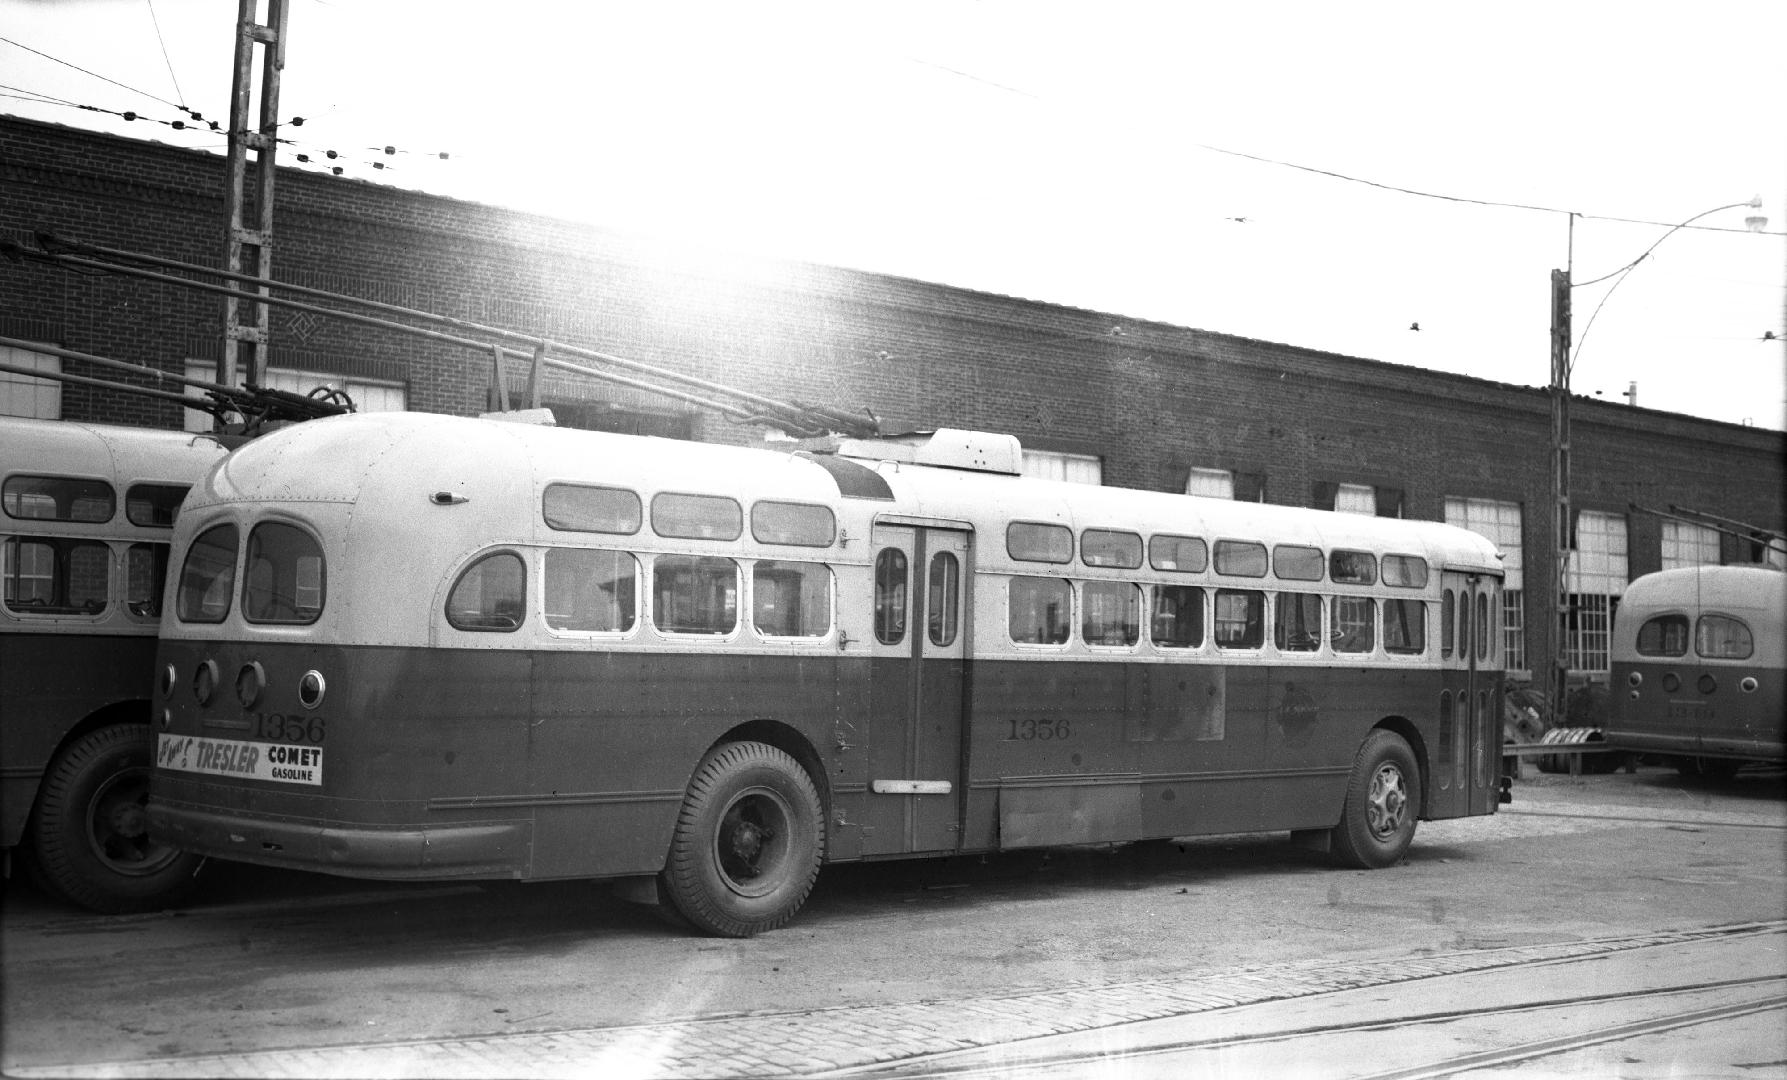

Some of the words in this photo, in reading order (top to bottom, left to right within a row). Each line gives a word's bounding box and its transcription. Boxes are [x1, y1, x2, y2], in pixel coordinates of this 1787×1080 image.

[255, 712, 326, 743] 1356
[1007, 719, 1070, 741] 1356
[196, 741, 260, 774] TRESLER
[268, 746, 321, 767] COMET
[272, 767, 313, 781] GASOLINE
